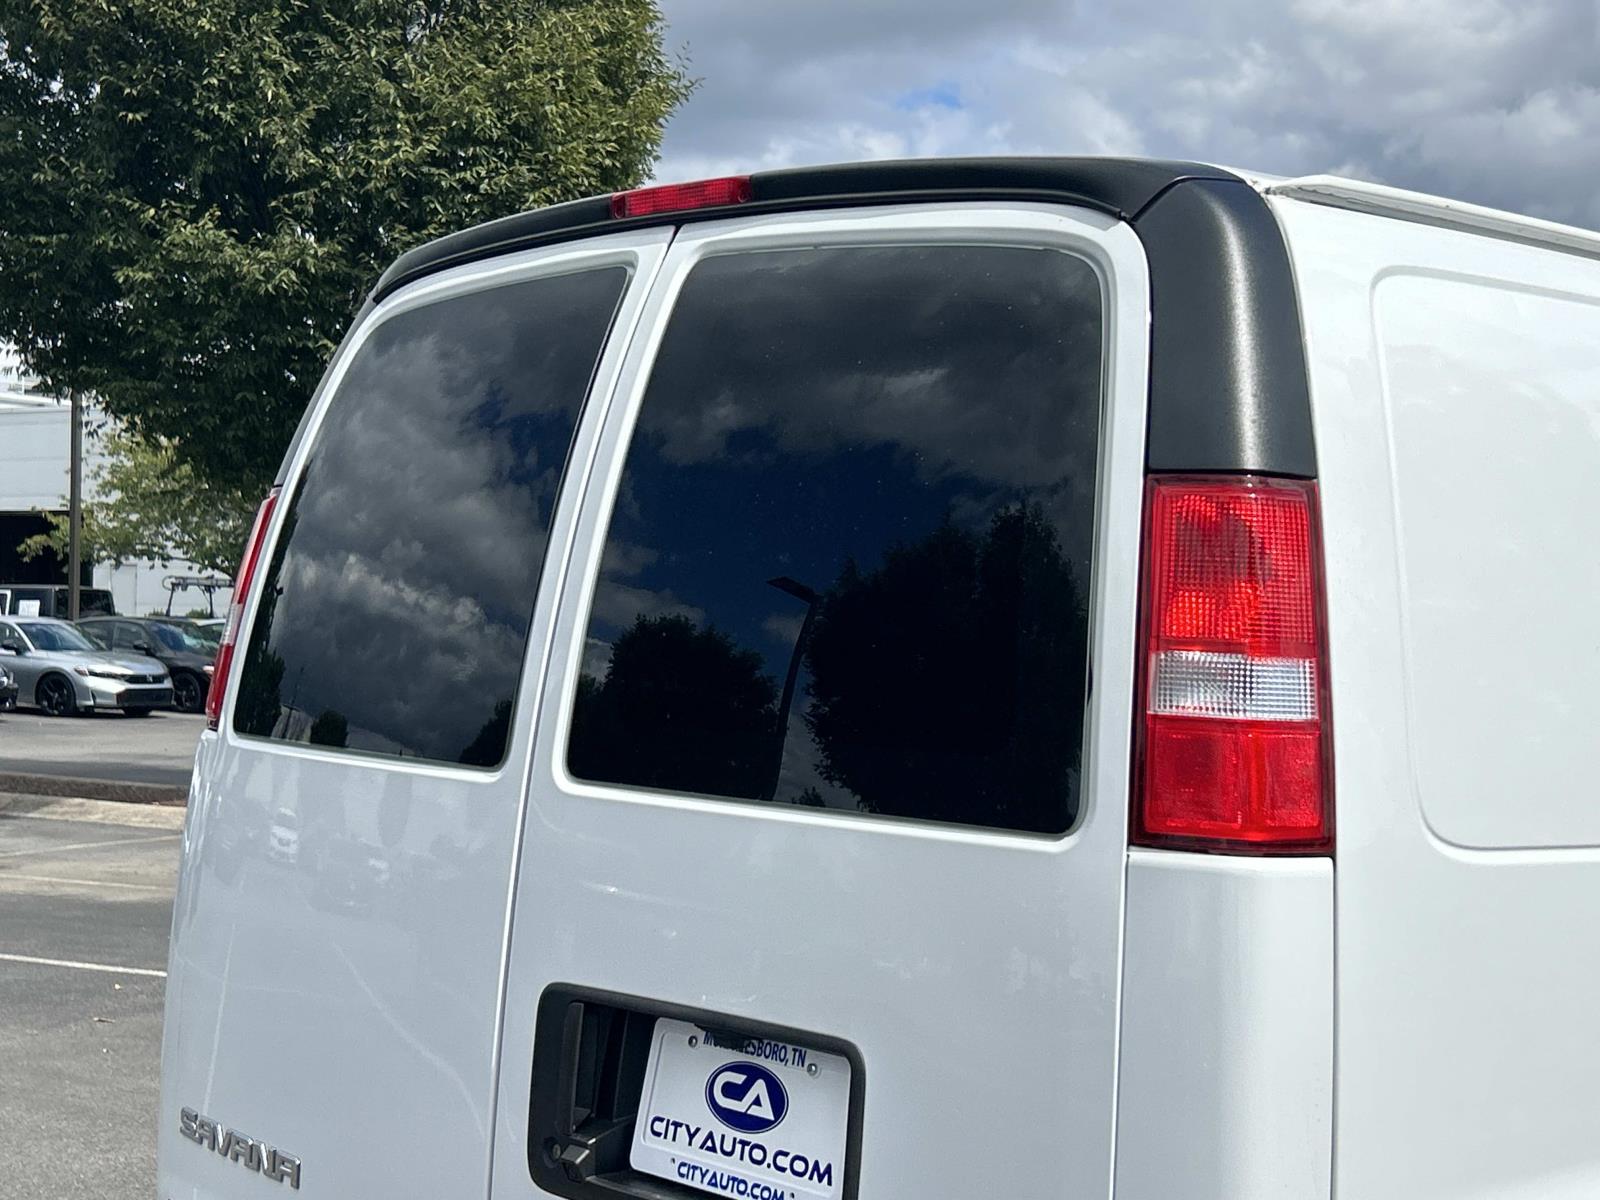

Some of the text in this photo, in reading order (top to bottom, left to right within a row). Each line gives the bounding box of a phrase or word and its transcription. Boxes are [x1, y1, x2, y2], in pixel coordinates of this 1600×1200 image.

[703, 1031, 807, 1067] MESBORO, TN
[714, 1071, 775, 1121] CA
[180, 1106, 301, 1190] SAVANA
[650, 1115, 833, 1187] CITYAUTO.COM
